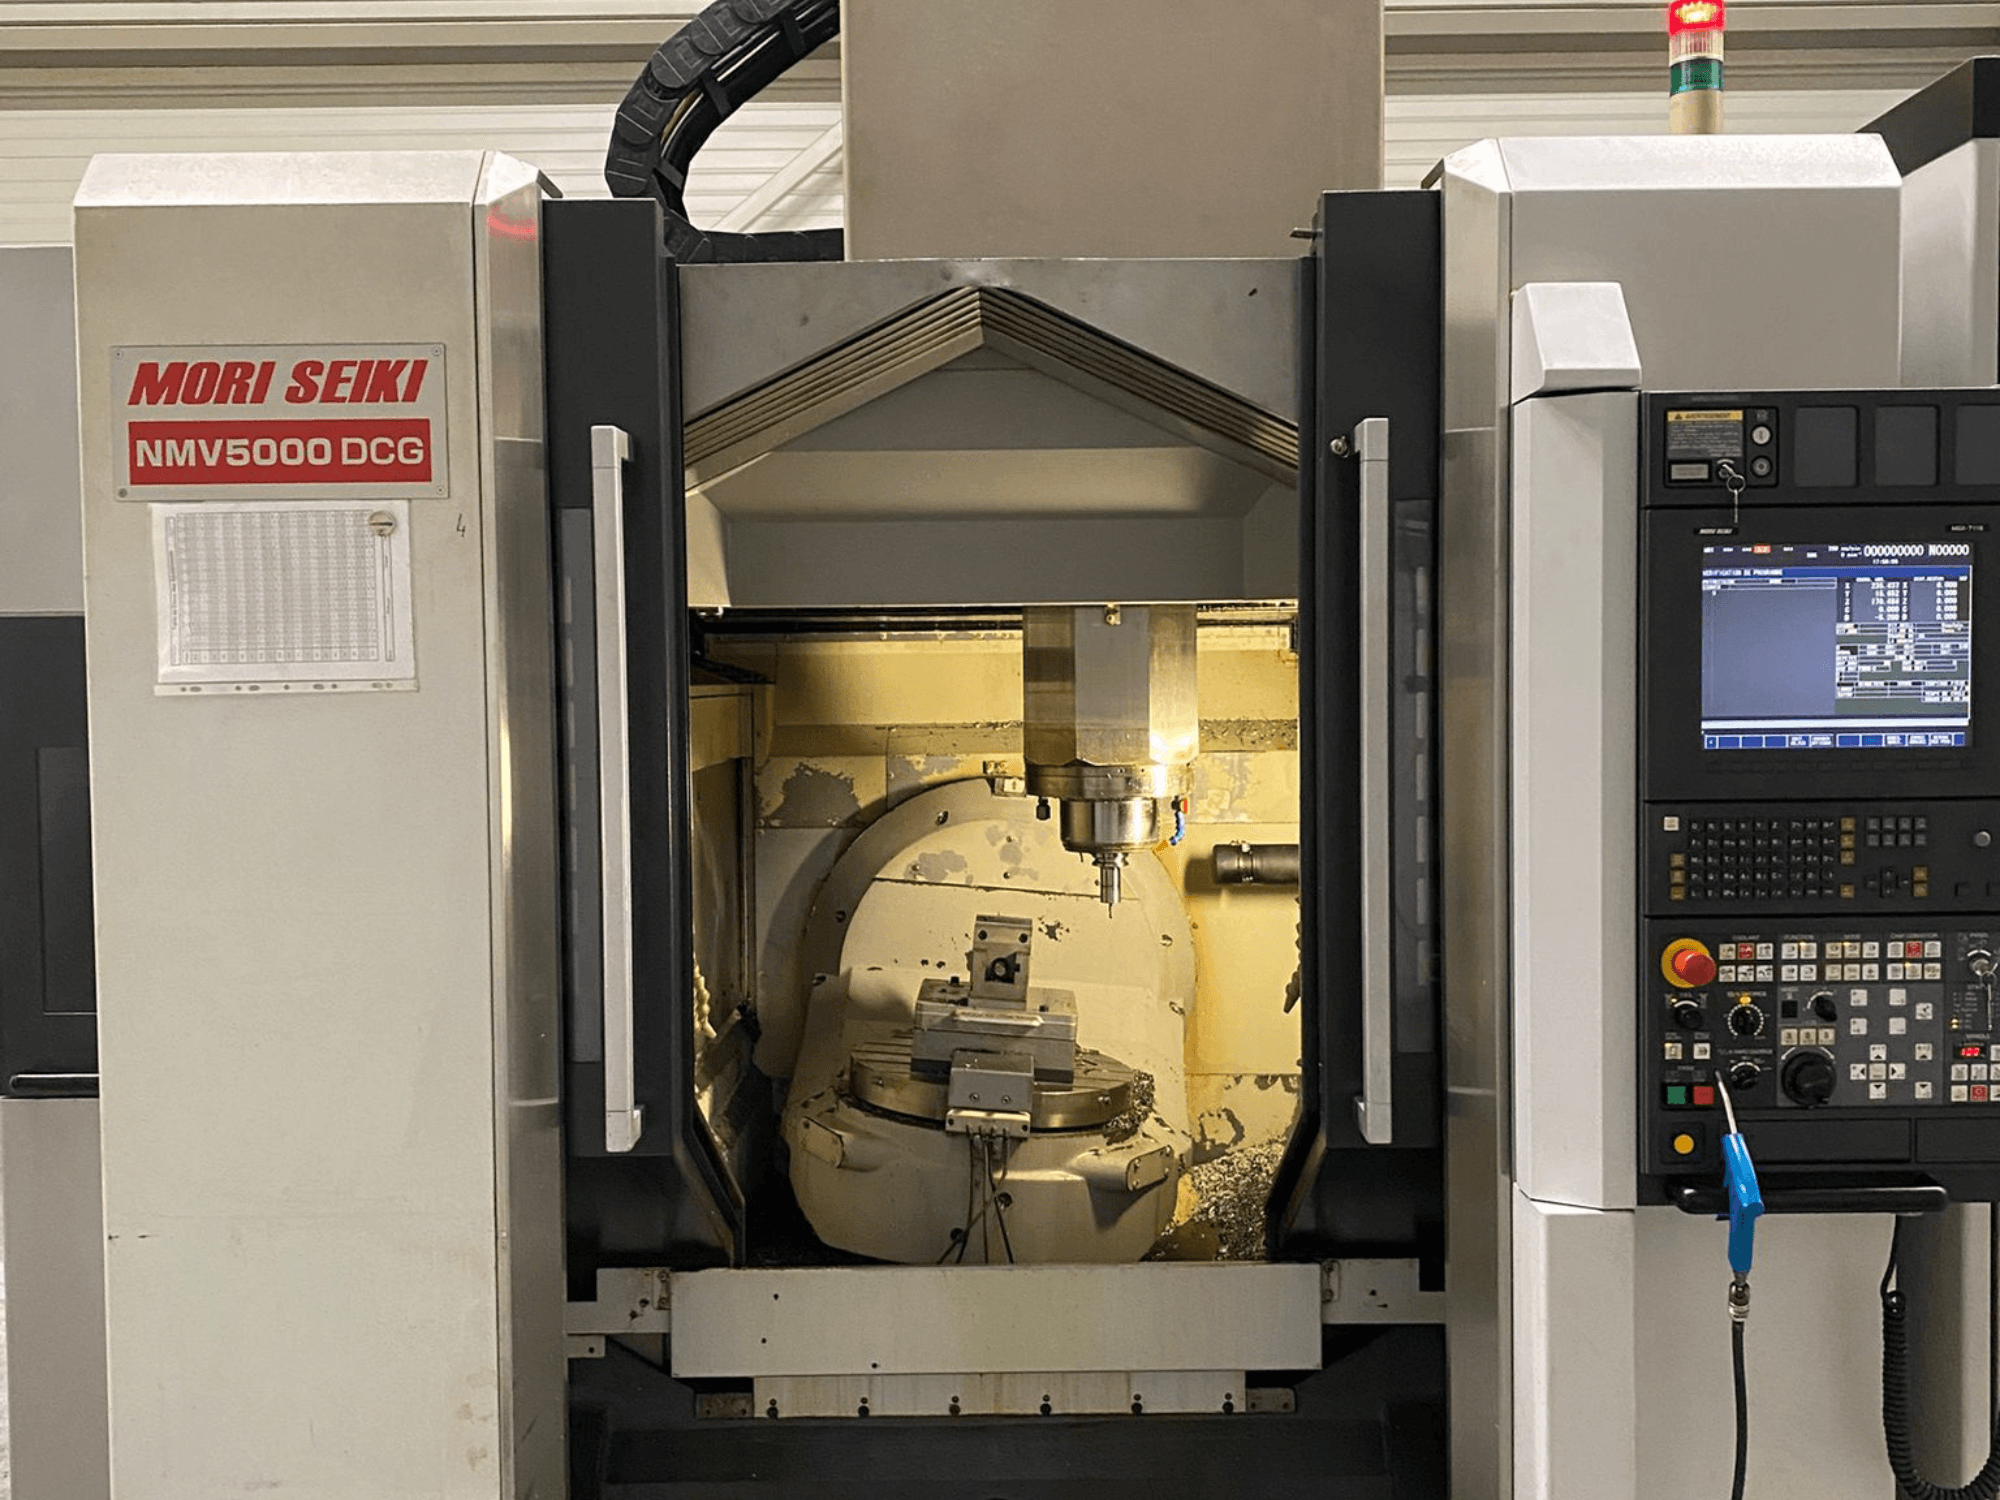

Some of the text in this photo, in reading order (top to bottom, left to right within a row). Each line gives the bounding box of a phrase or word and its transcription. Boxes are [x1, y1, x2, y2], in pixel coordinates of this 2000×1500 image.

[127, 359, 428, 406] MORI SEIKI
[135, 436, 424, 467] NMV5000 DCG
[456, 513, 466, 537] 4
[1929, 544, 1970, 556] N00000
